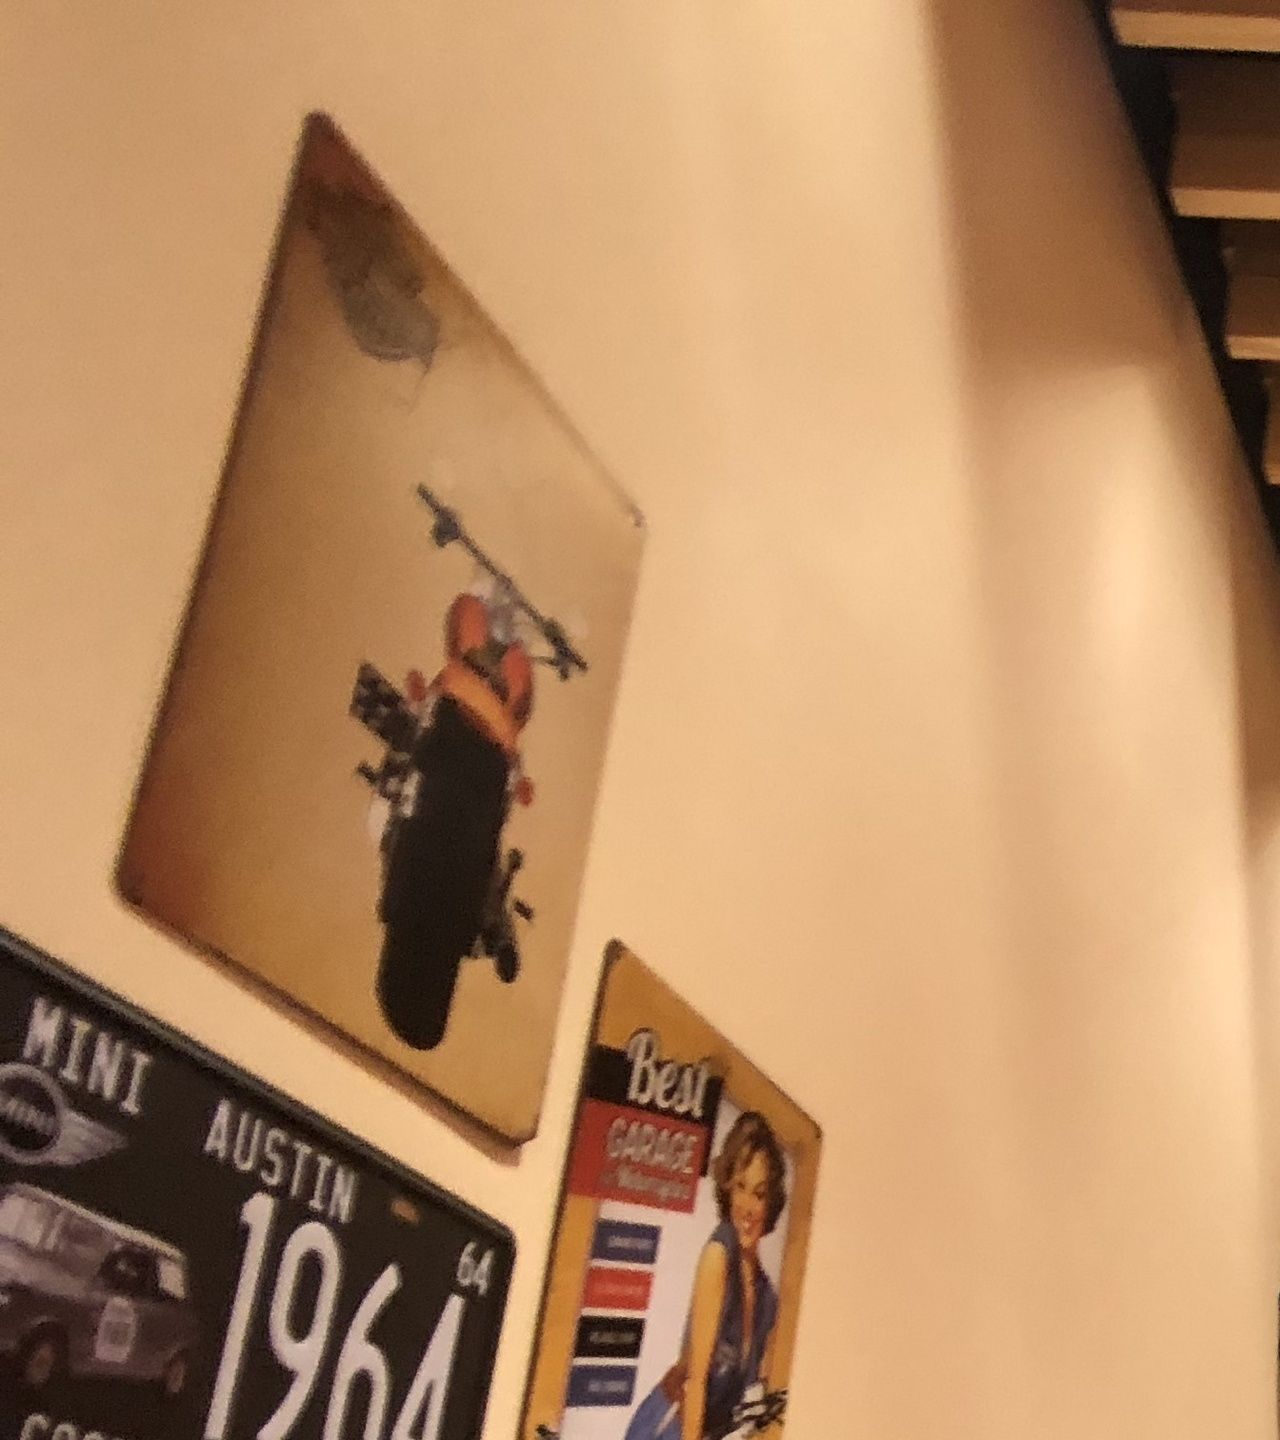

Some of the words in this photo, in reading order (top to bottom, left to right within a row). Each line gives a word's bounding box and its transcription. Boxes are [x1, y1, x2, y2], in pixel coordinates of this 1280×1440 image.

[23, 997, 152, 1116] MINI
[627, 1028, 714, 1118] Best
[204, 1099, 359, 1225] AUSTIN
[606, 1116, 699, 1175] GARAGE
[457, 1241, 495, 1296] 64
